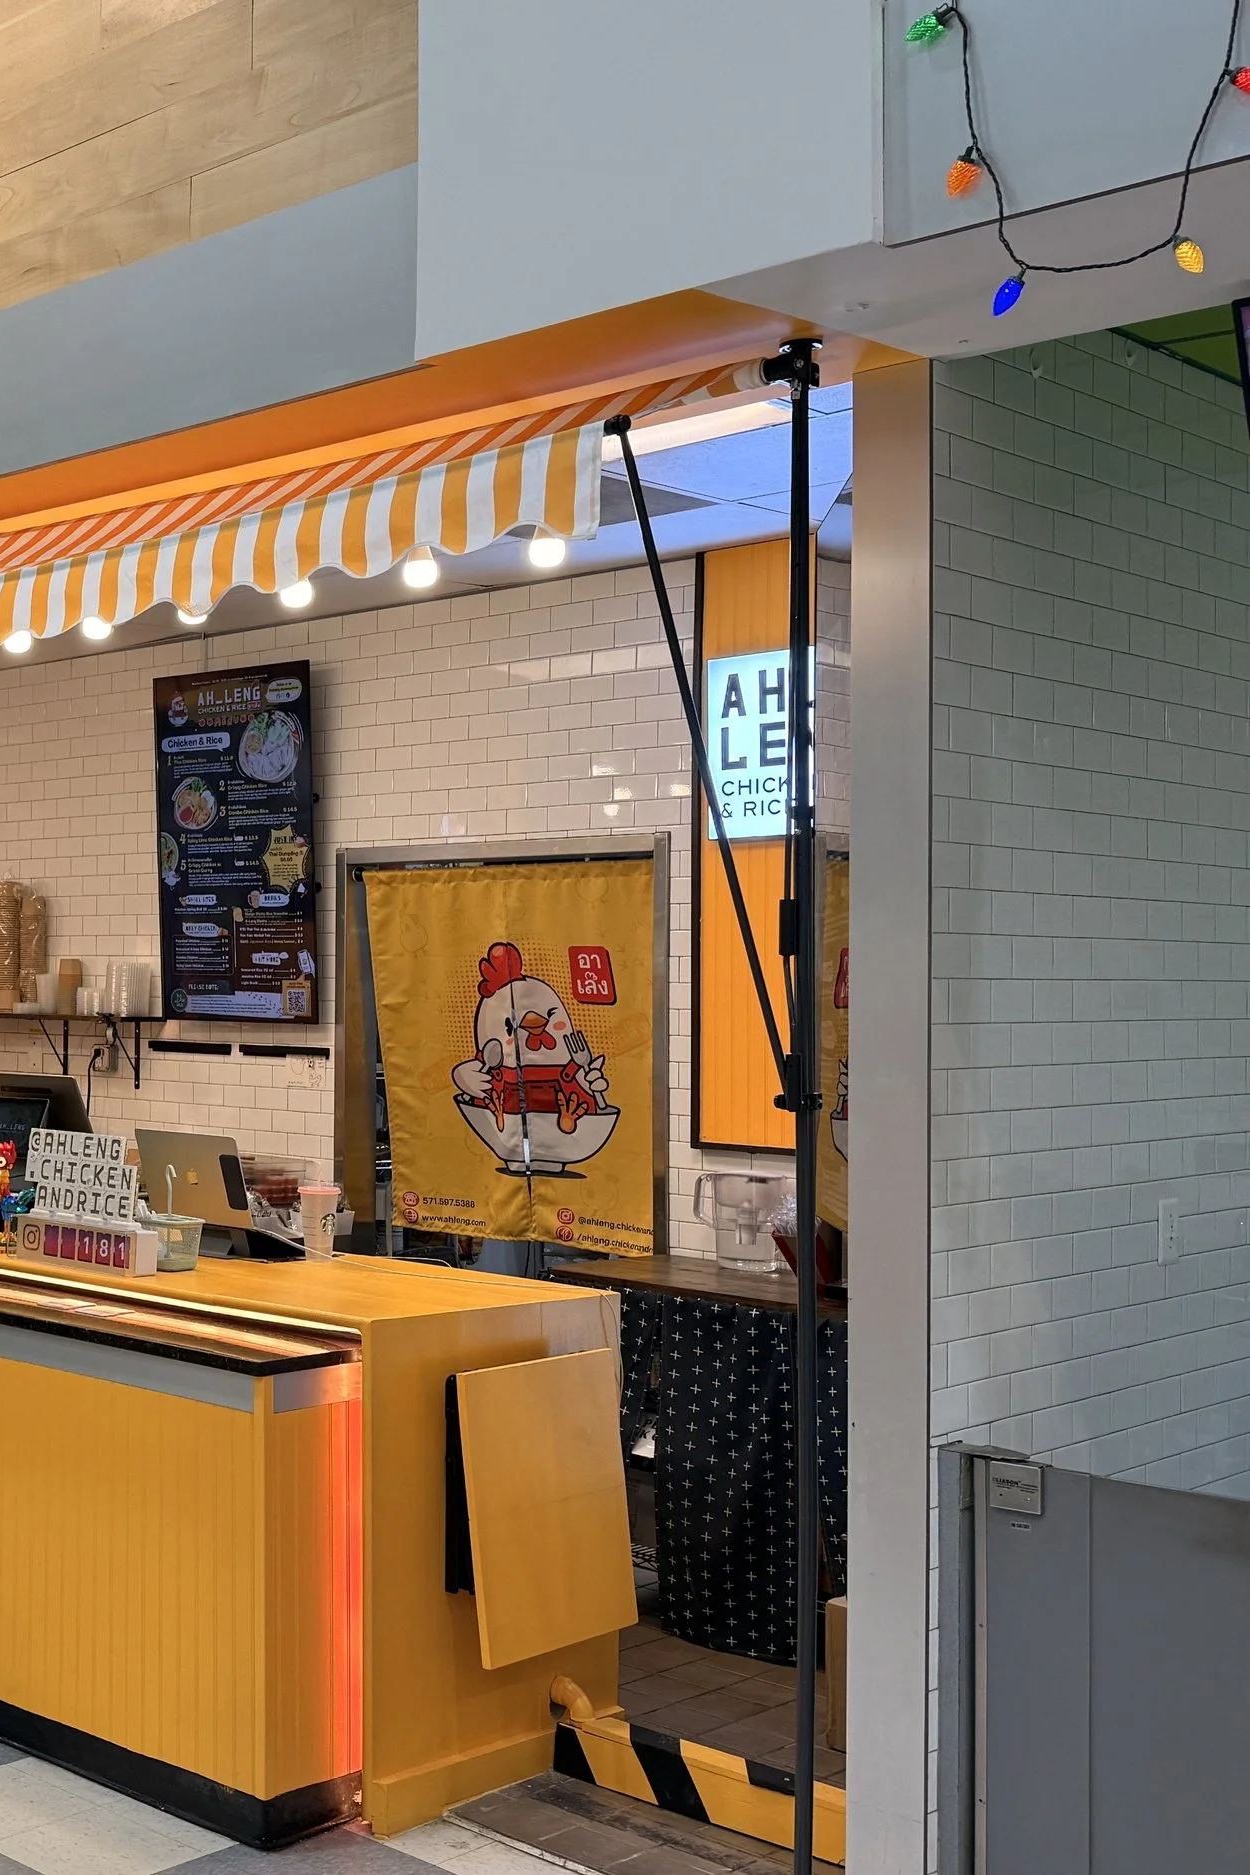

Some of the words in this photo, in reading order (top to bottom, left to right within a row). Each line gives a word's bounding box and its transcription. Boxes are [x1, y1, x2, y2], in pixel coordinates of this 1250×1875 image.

[198, 706, 225, 715] CHICKEN
[231, 703, 247, 711] RICE
[167, 738, 198, 748] Chicken
[198, 737, 205, 746] &
[206, 735, 223, 745] Rice
[219, 780, 225, 791] 2
[721, 776, 790, 797] CHICK
[219, 806, 226, 817] 3
[721, 802, 733, 819] &
[743, 799, 788, 817] RIC
[179, 833, 187, 845] 4
[180, 859, 186, 871] 5
[577, 953, 602, 969] อา
[30, 1131, 122, 1162] @AHLENG
[36, 1185, 131, 1219] ANDRICE
[83, 1236, 125, 1261] 181
